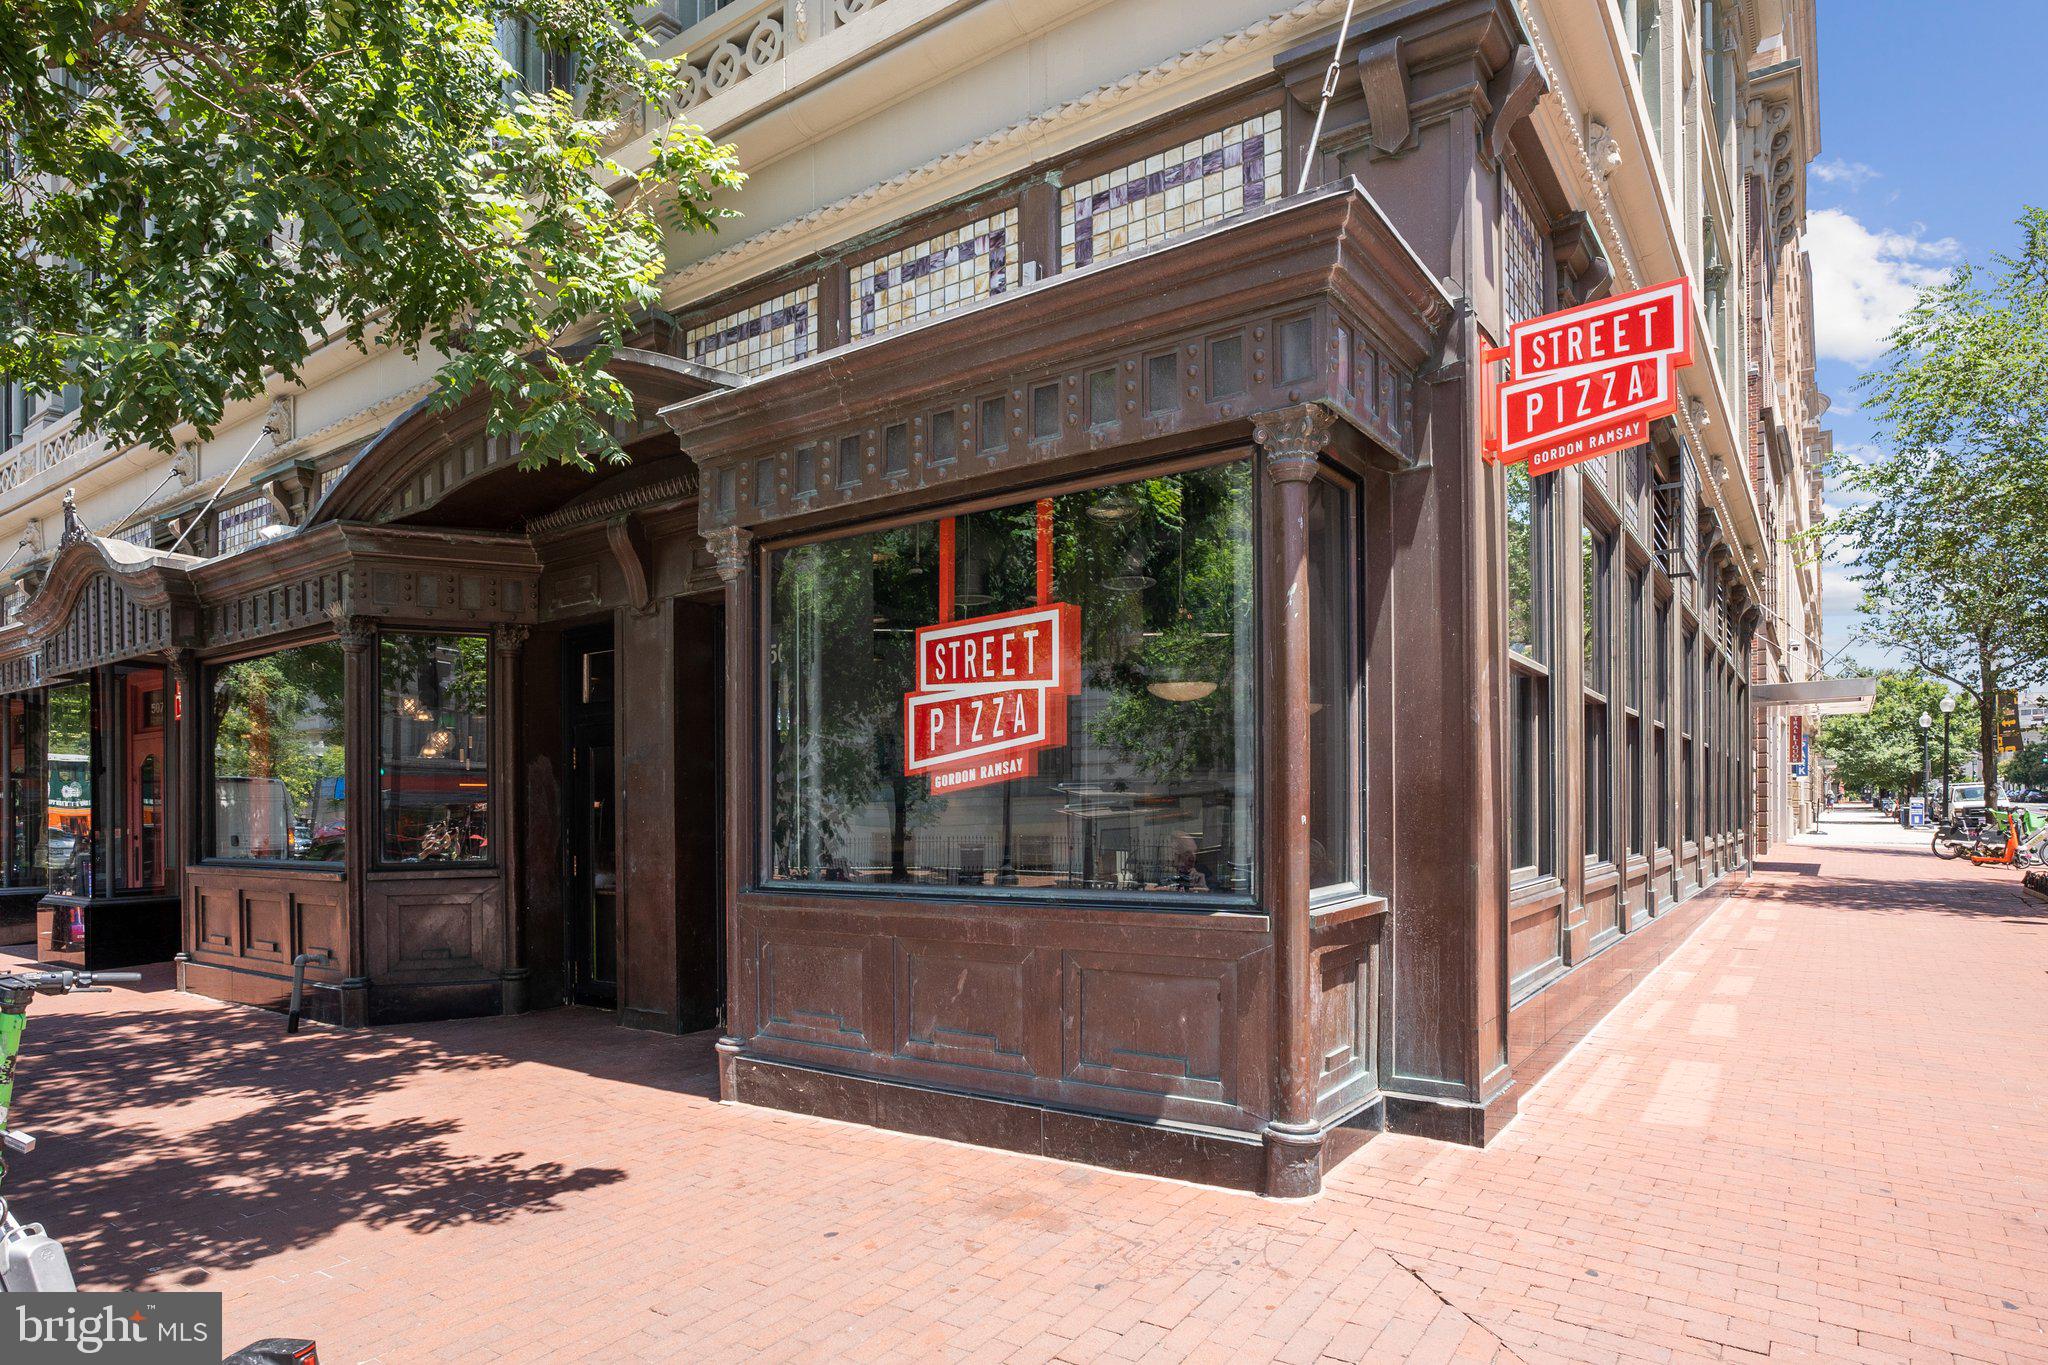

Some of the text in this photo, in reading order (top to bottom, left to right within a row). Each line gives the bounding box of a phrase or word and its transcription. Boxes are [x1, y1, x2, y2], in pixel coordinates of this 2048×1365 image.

[1532, 306, 1658, 369] STREET
[1526, 364, 1643, 433] PIZZA
[1533, 422, 1640, 465] GORDON RAMSAY
[935, 629, 1039, 680] STREET
[930, 693, 1026, 751] PIZZA
[934, 757, 1024, 788] GORDON RAMSAY
